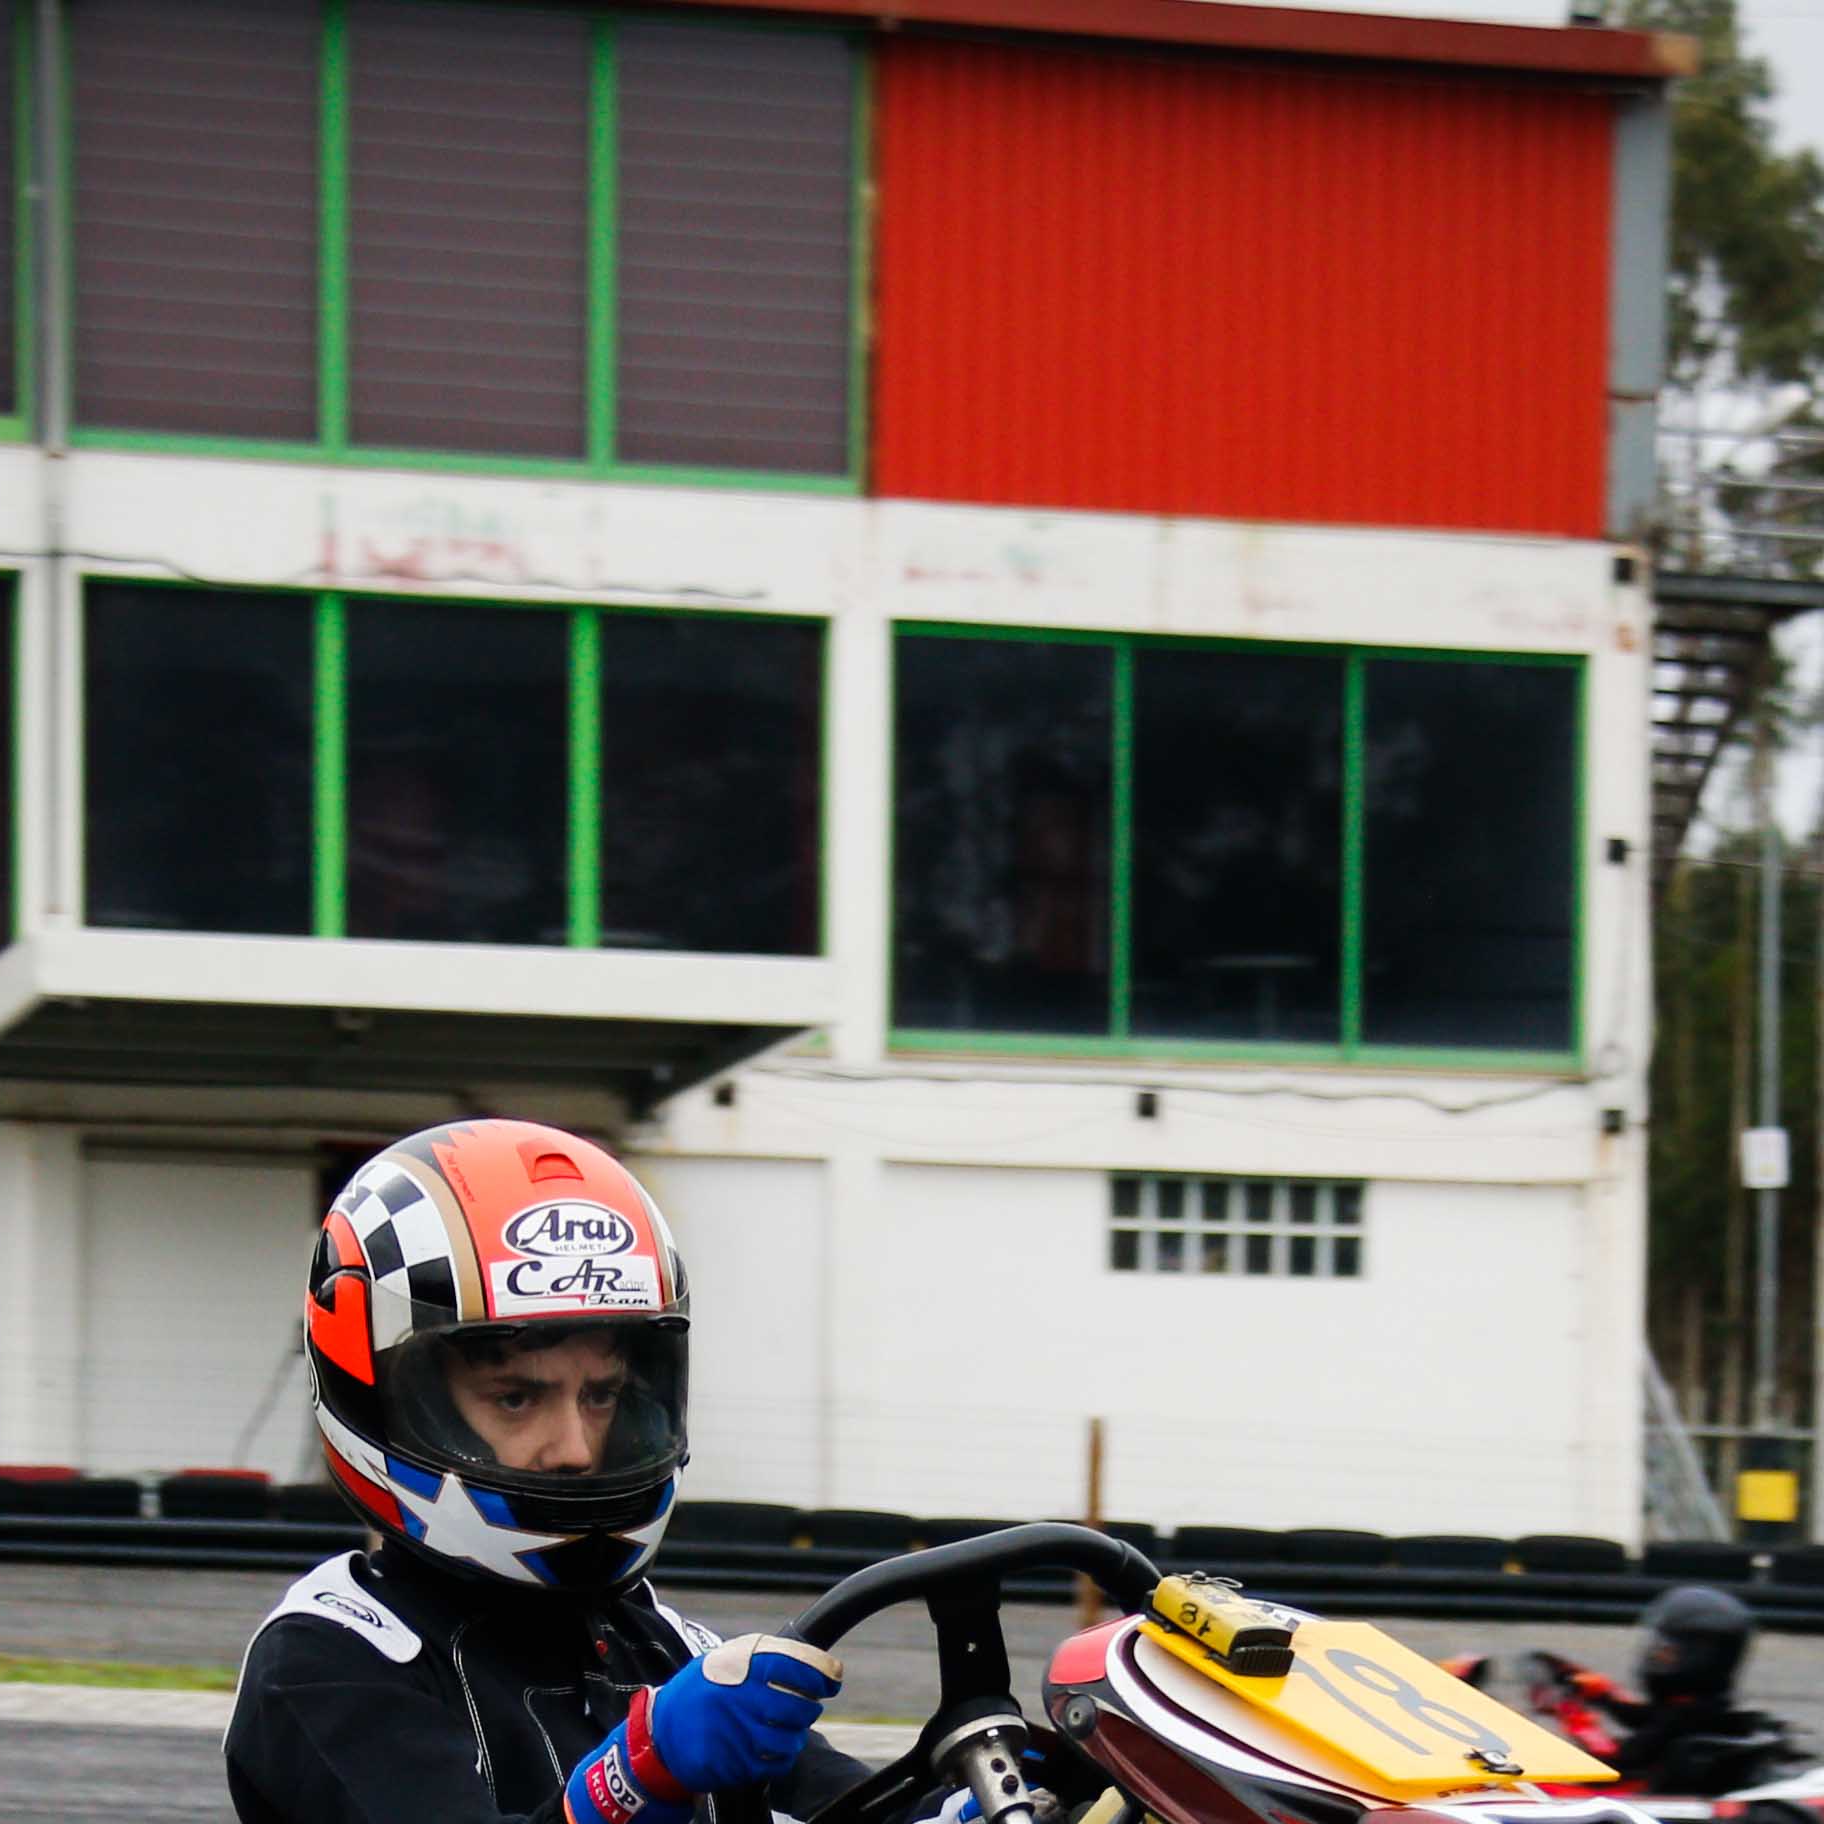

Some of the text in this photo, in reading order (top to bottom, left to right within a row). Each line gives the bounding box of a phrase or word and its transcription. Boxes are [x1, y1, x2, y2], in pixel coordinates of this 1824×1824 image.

[519, 1208, 621, 1247] Arai
[1290, 1648, 1513, 1755] 18
[605, 1750, 638, 1807] TOP
